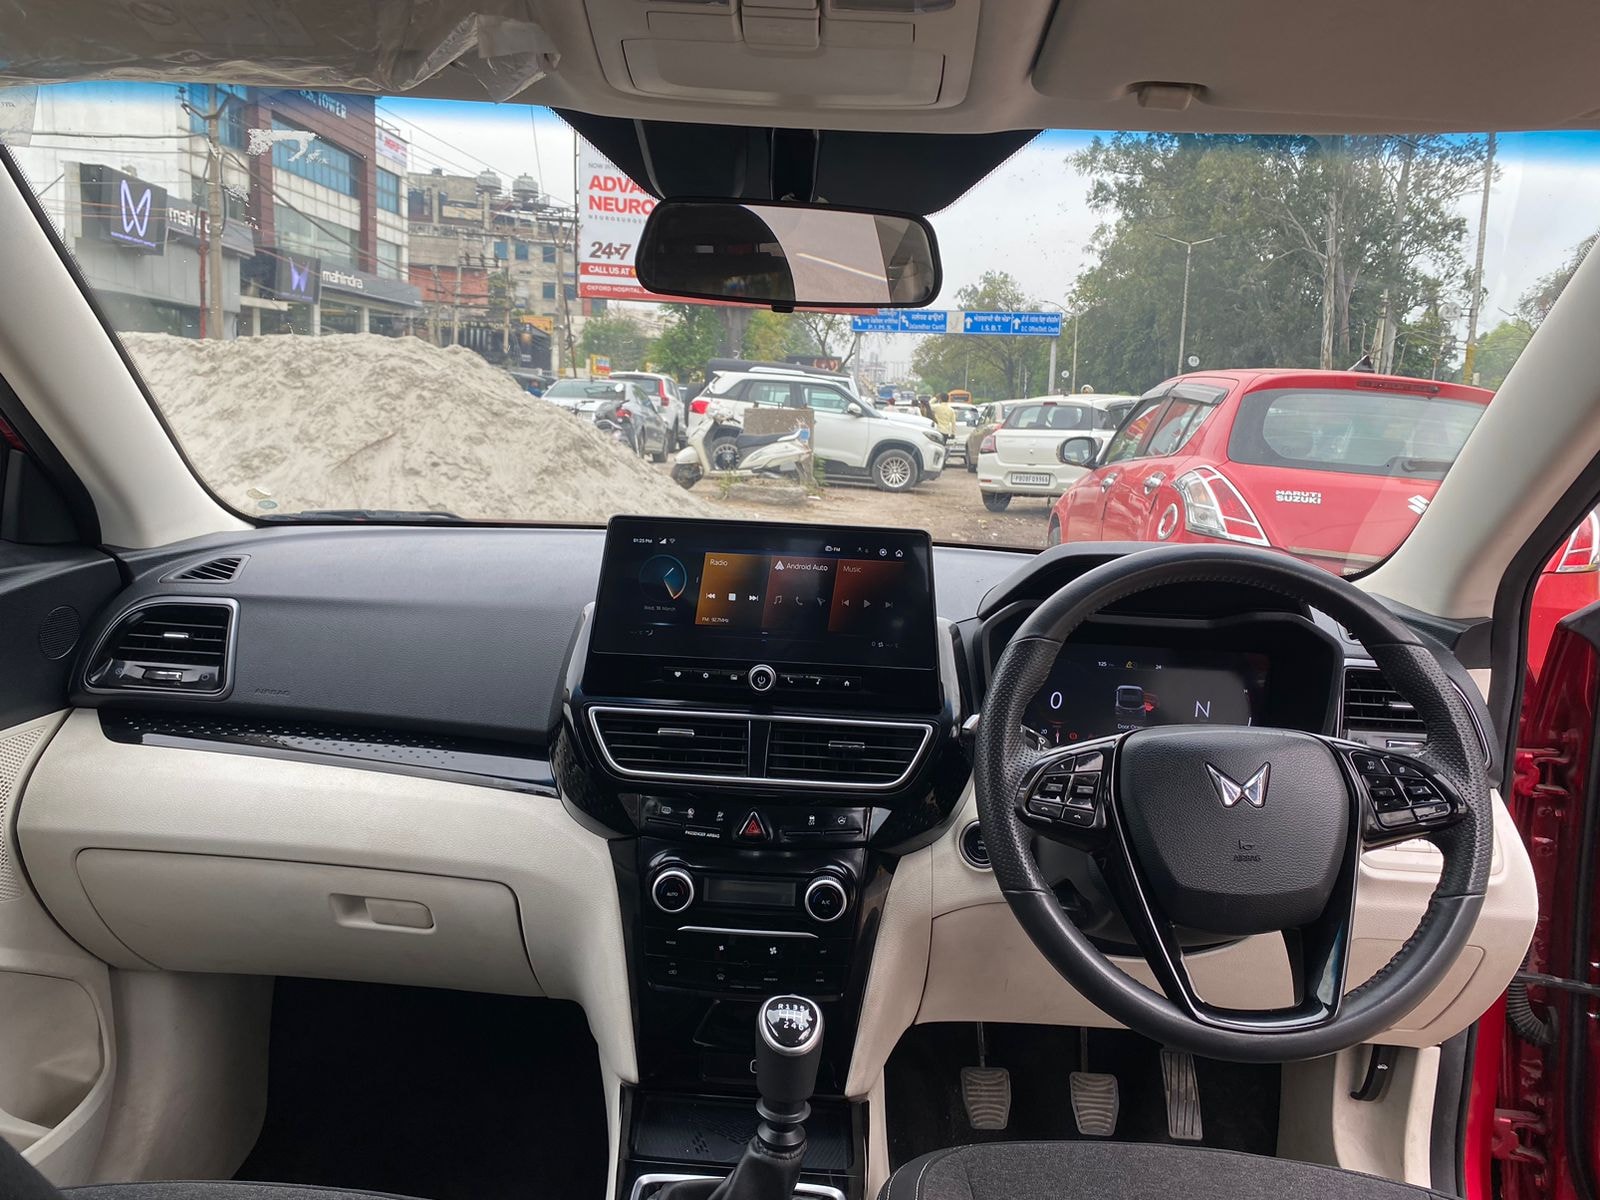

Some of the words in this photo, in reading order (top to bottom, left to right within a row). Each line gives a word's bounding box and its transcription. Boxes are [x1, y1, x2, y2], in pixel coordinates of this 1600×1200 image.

[318, 92, 347, 119] TOWER
[588, 265, 608, 274] CALL
[609, 266, 620, 275] US
[620, 268, 630, 276] AT
[322, 270, 363, 289] mahindra
[586, 284, 611, 292] OXFORD
[1275, 490, 1321, 498] MARUTI
[1275, 495, 1321, 504] SUZUKI
[709, 559, 728, 567] Radio
[786, 562, 812, 571] Android
[843, 565, 862, 573] Music
[1050, 691, 1062, 710] 0
[1194, 700, 1211, 718] N
[783, 1021, 789, 1029] 2
[798, 1023, 804, 1031] 6
